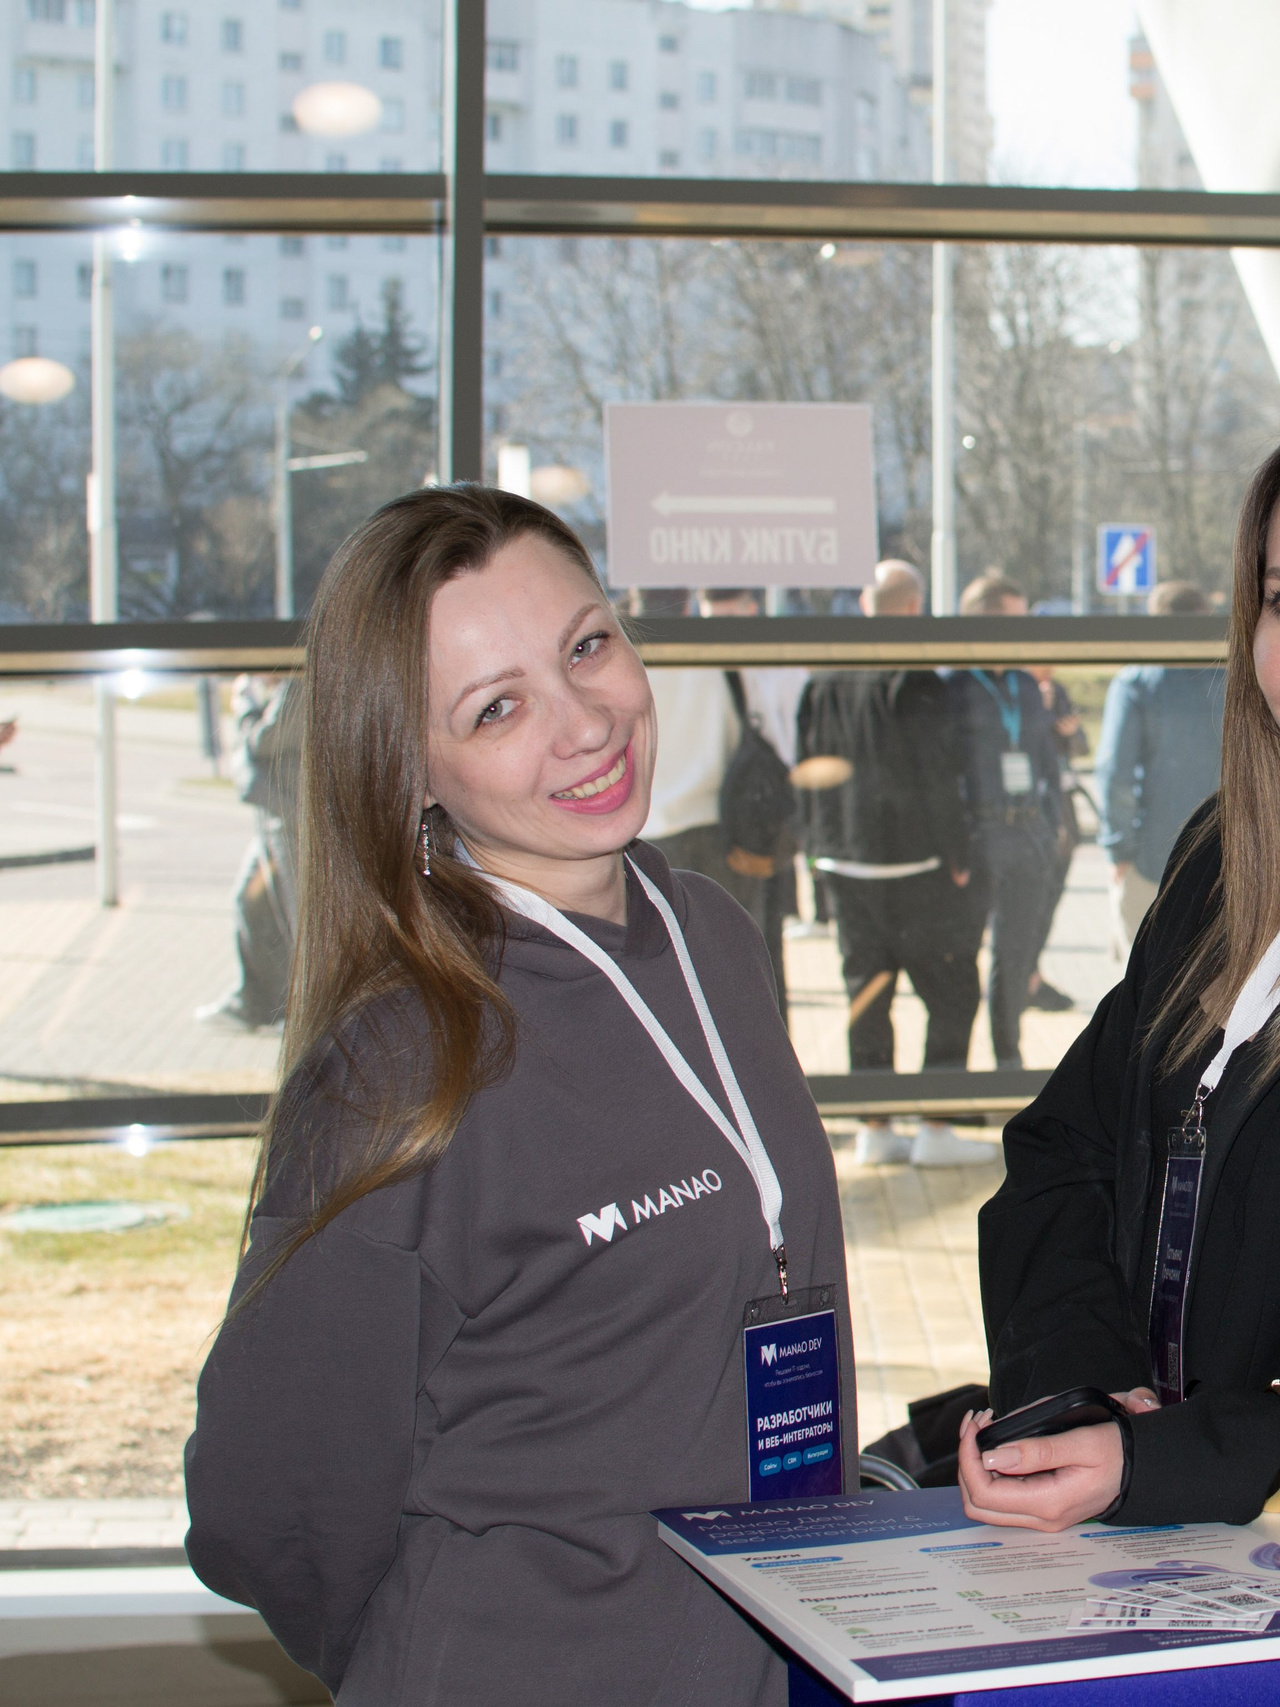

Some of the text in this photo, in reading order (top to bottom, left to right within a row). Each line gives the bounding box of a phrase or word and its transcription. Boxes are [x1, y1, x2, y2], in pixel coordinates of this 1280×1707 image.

[631, 1168, 722, 1224] MANAO
[779, 1337, 823, 1358] MANAO DEV
[757, 1400, 833, 1432] РАЗРАБОТЧИКИ
[758, 1421, 834, 1451] И ВЕБ-ИНТЕГРАТОРЫ
[740, 1500, 875, 1516] MANAO DEV
[698, 1520, 790, 1532] Манао
[708, 1518, 897, 1539] разработчики
[799, 1587, 938, 1603] Преимущества
